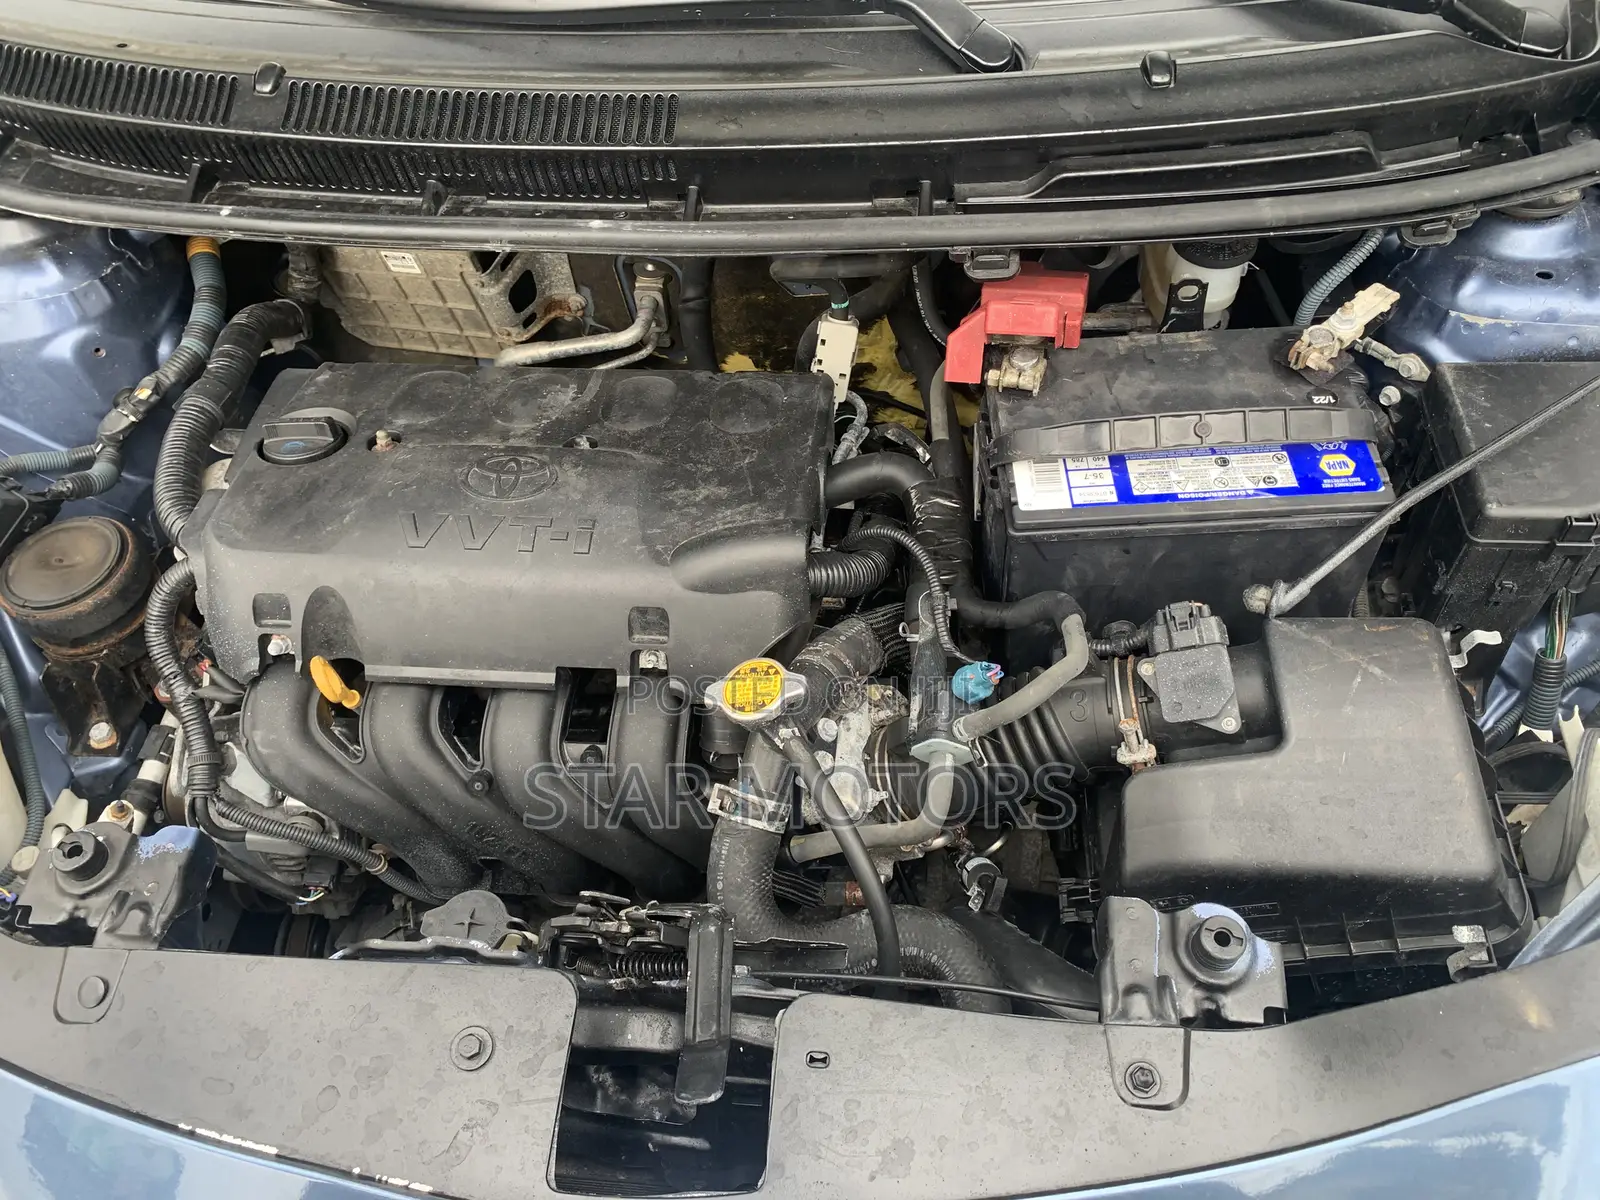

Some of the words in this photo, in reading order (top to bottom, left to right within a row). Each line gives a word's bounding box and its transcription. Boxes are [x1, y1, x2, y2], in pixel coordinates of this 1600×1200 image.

[1311, 395, 1336, 404] 1/22
[1325, 459, 1351, 470] NAPA
[399, 511, 597, 555] VVT-i
[1069, 688, 1089, 723] 3
